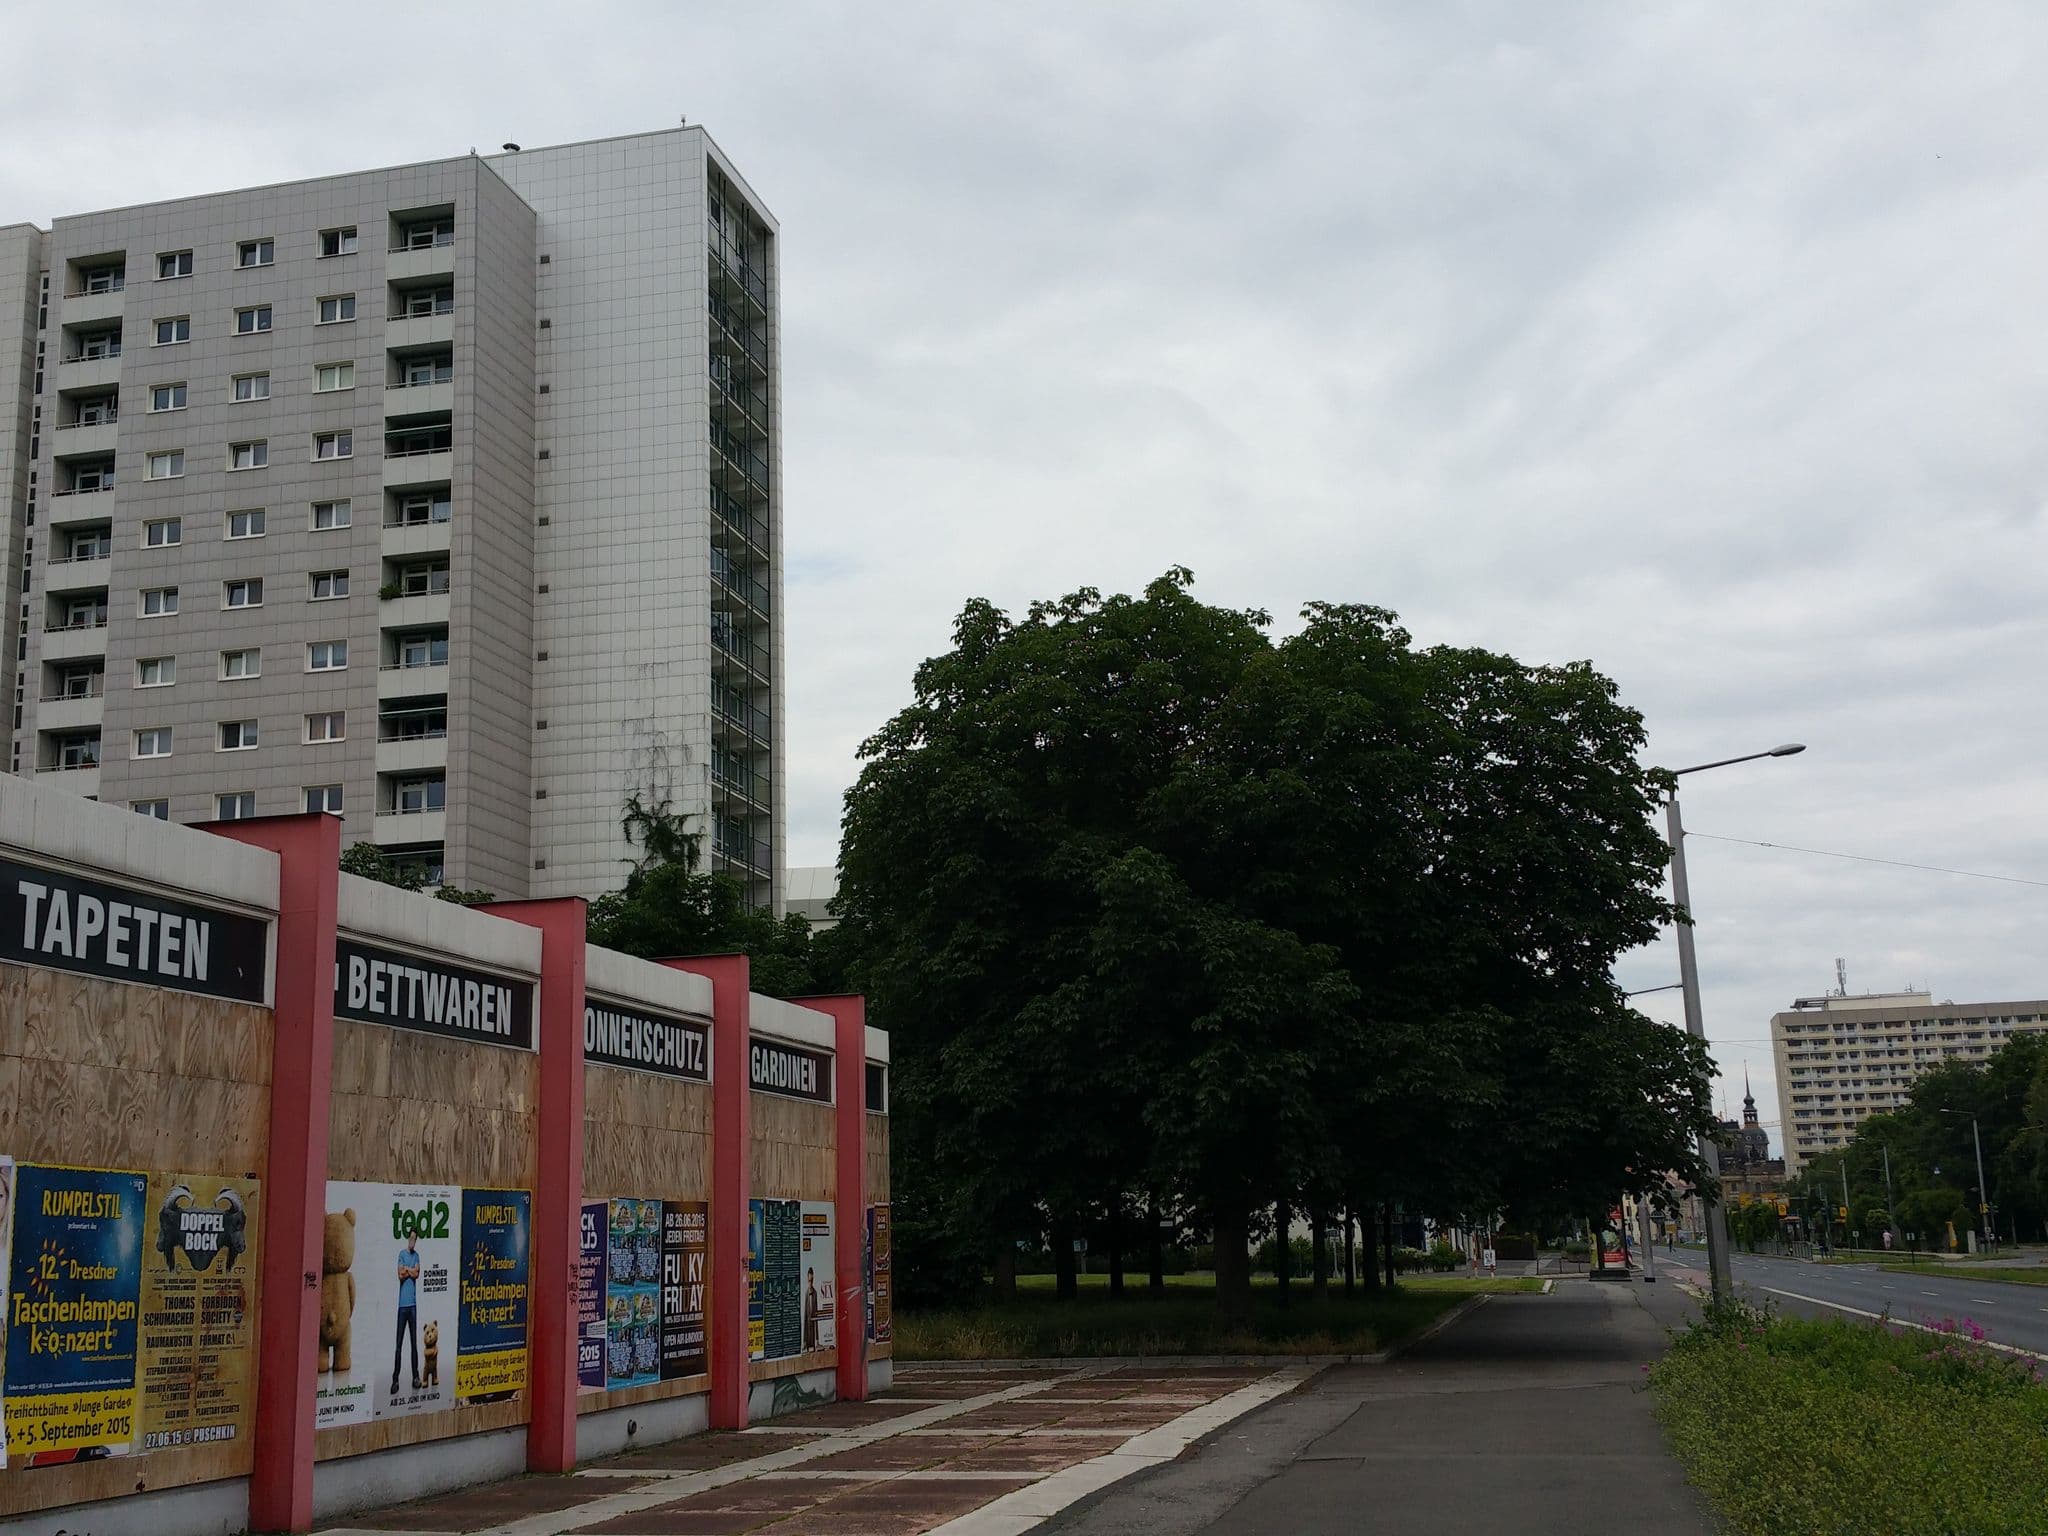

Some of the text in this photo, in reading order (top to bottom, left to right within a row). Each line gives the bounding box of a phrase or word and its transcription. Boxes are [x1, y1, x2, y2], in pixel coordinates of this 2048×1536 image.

[18, 880, 209, 982] TAPETEN
[347, 954, 512, 1036] BETTWAREN
[751, 1045, 817, 1094] GARDINEN
[42, 1189, 122, 1220] RUMPELSTIL
[180, 1213, 225, 1233] DOPPEL
[475, 1205, 519, 1226] RUMPELSTIL
[665, 1213, 674, 1228] AB
[185, 1232, 219, 1252] BOCK
[39, 1253, 60, 1281] 12.
[69, 1257, 118, 1281] Dresdner
[461, 1279, 527, 1305] Taschenlampen
[13, 1291, 136, 1330] Taschenlampen
[165, 1296, 195, 1310] THOMAS
[202, 1296, 242, 1309] FORBIDDEN
[144, 1312, 195, 1327] SCHUMACHER
[201, 1311, 232, 1325] SOCIETY
[200, 1334, 225, 1346] FORMAT
[580, 1344, 601, 1362] 2015
[477, 1371, 511, 1391] September
[4, 1402, 69, 1420] Freilichtbühne
[340, 1403, 356, 1414] KINO
[26, 1422, 38, 1446] 5.
[40, 1411, 104, 1447] September
[106, 1415, 131, 1436] 2015
[145, 1430, 182, 1449] 27.06.15
[193, 1424, 237, 1443] PUSCHKIN
